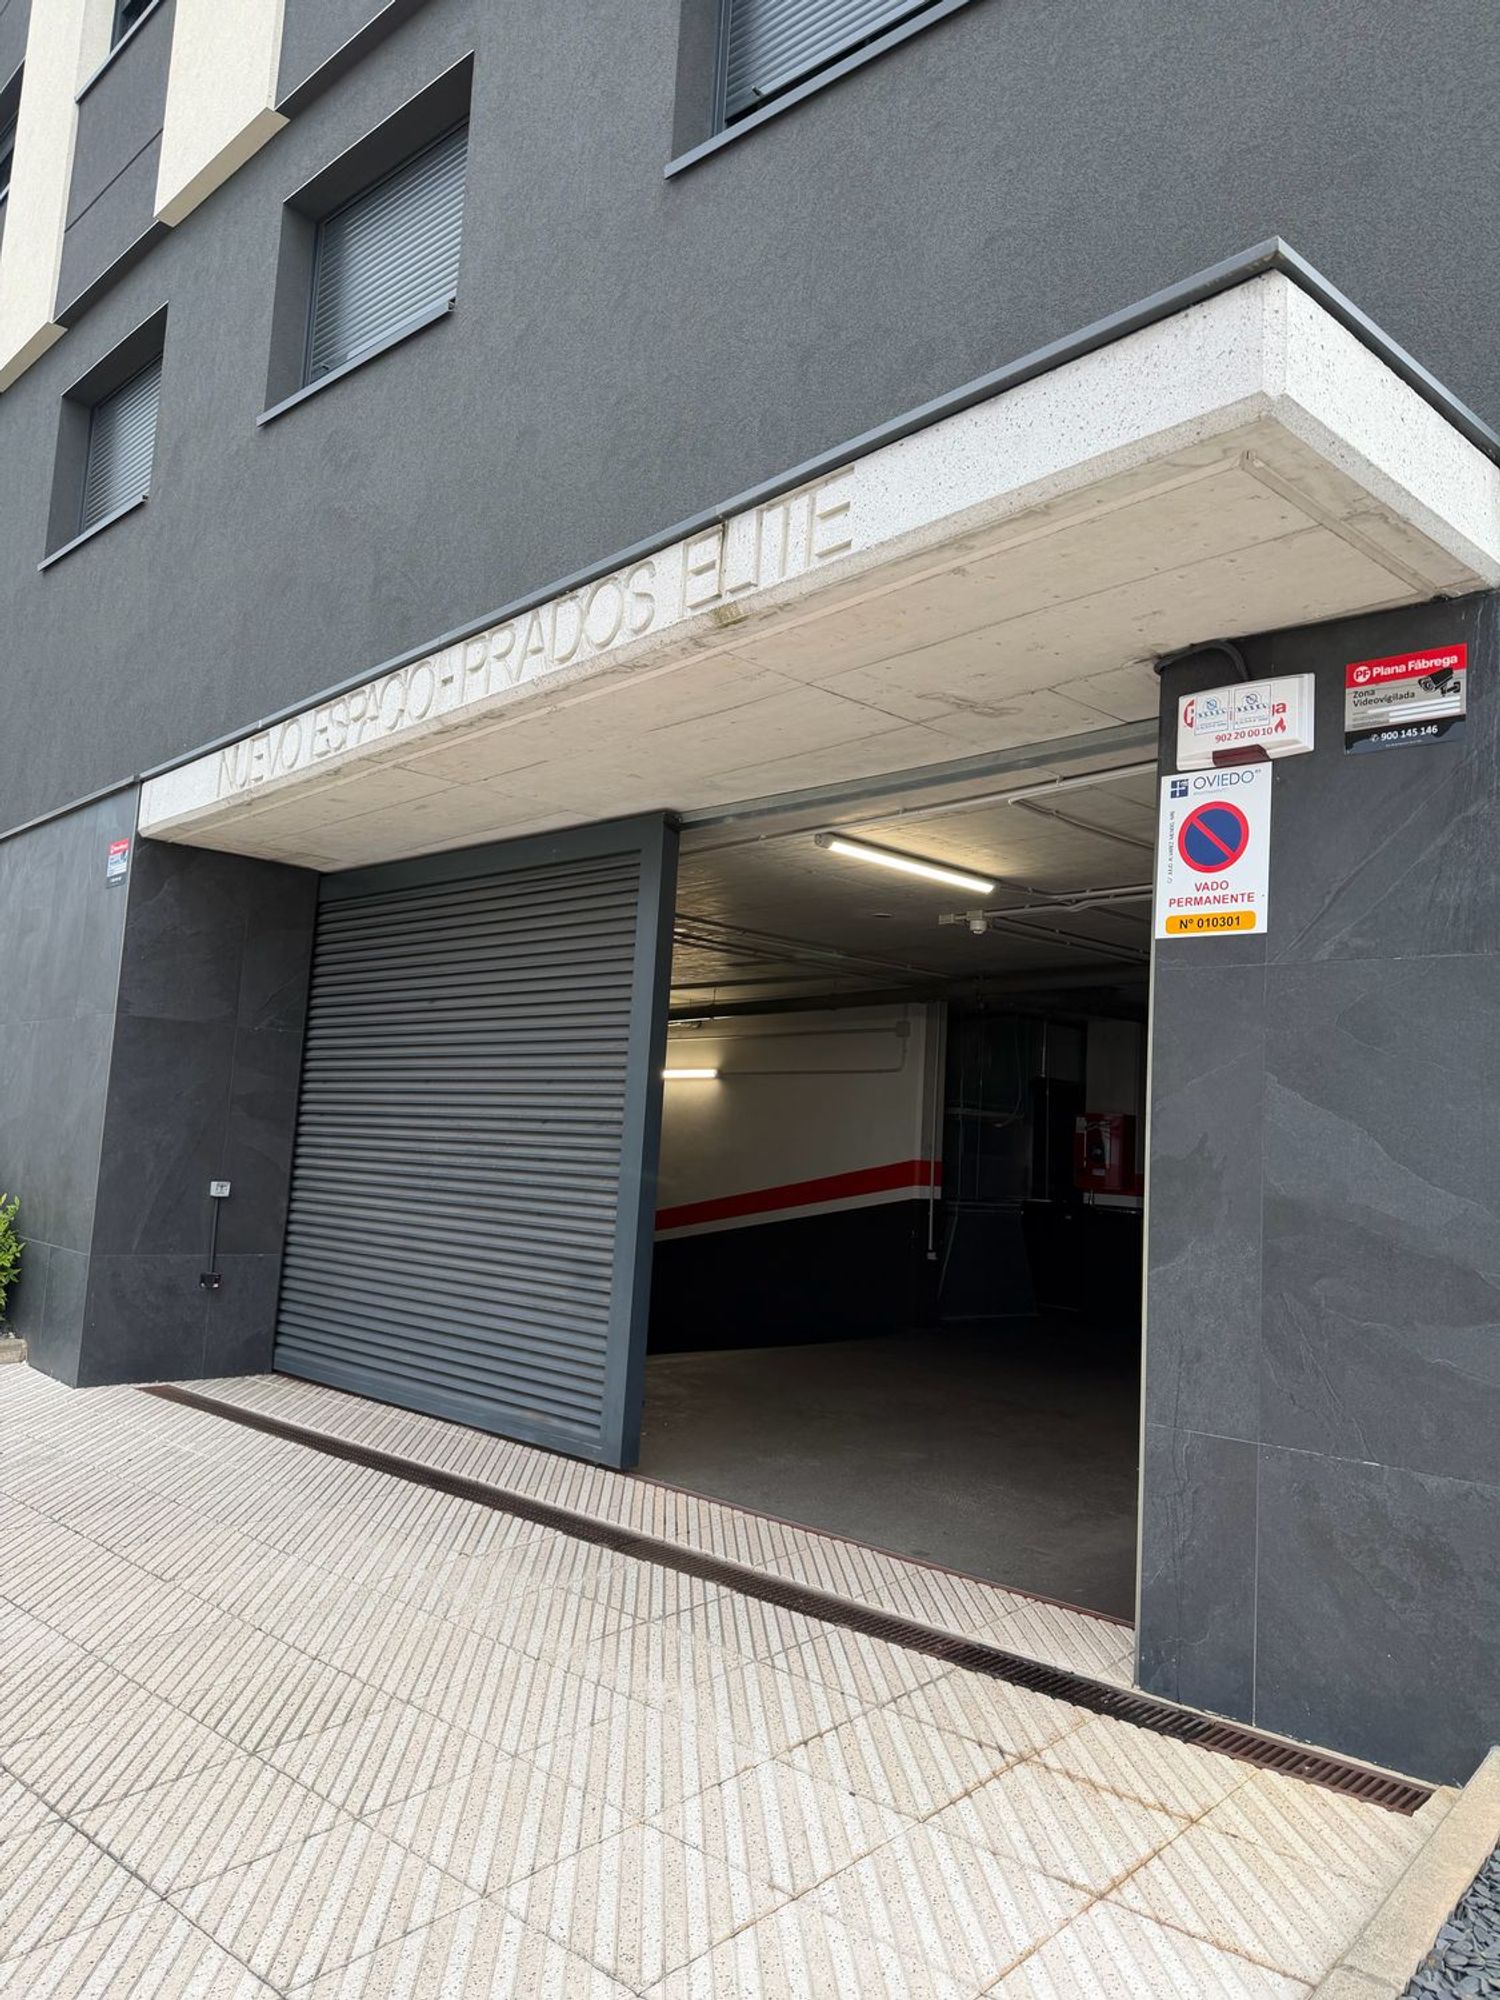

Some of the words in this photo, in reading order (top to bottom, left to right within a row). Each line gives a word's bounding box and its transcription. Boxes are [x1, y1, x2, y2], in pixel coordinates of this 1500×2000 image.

[216, 718, 300, 798] NUEVO
[681, 463, 856, 618] ELITE
[1372, 663, 1406, 678] Plana
[1408, 655, 1458, 672] Fábrega
[1352, 689, 1376, 699] Zona
[1352, 691, 1416, 707] Videovigilada
[1215, 733, 1232, 743] 902
[1380, 730, 1399, 741] 900
[1401, 728, 1418, 738] 145
[1420, 725, 1438, 736] 146
[1193, 770, 1255, 790] OVIEDO
[1194, 880, 1229, 892] VADO
[1168, 892, 1255, 908] PERMANENTE
[1197, 915, 1240, 928] 010301
